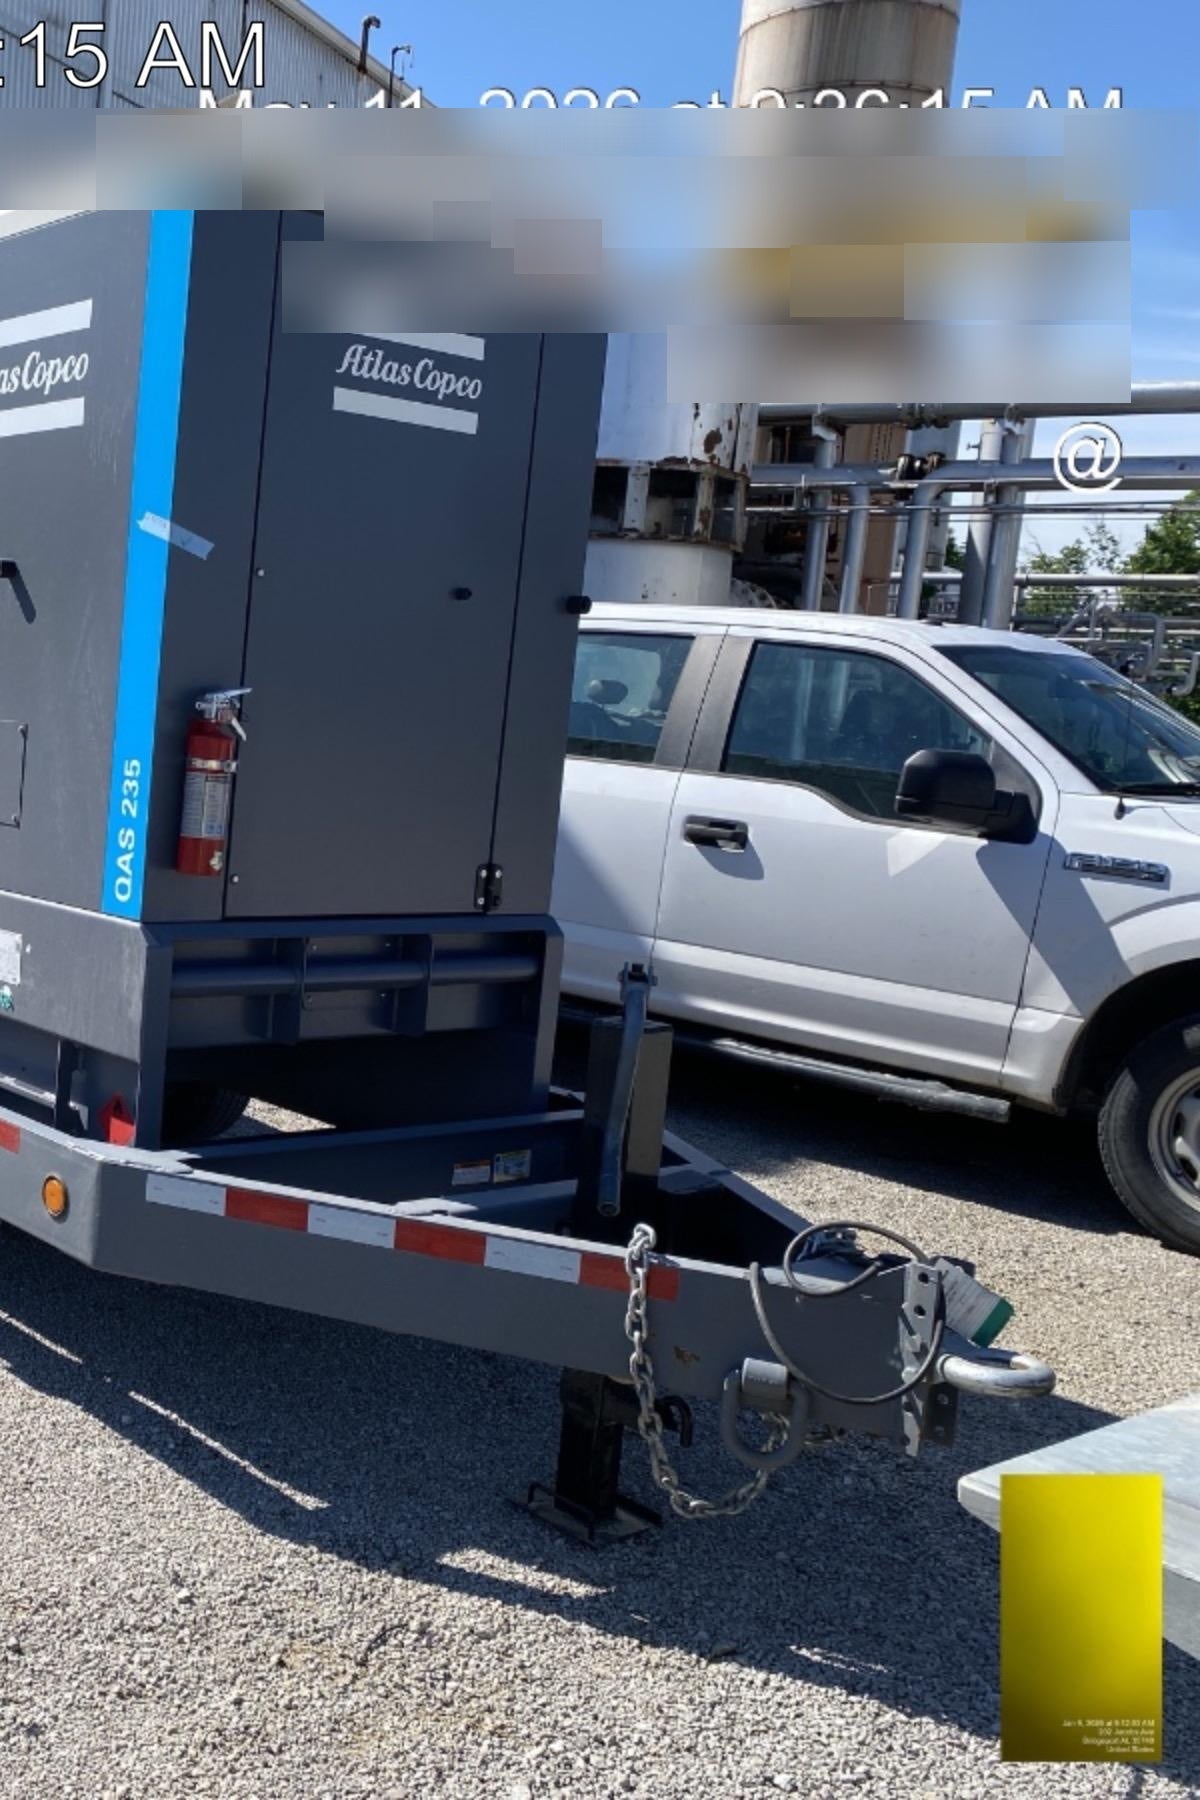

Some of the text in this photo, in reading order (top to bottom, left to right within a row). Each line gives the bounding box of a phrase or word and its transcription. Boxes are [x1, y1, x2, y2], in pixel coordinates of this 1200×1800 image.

[21, 350, 90, 395] Copco
[335, 343, 483, 401] Atlas Copco
[114, 759, 142, 903] QAS 235
